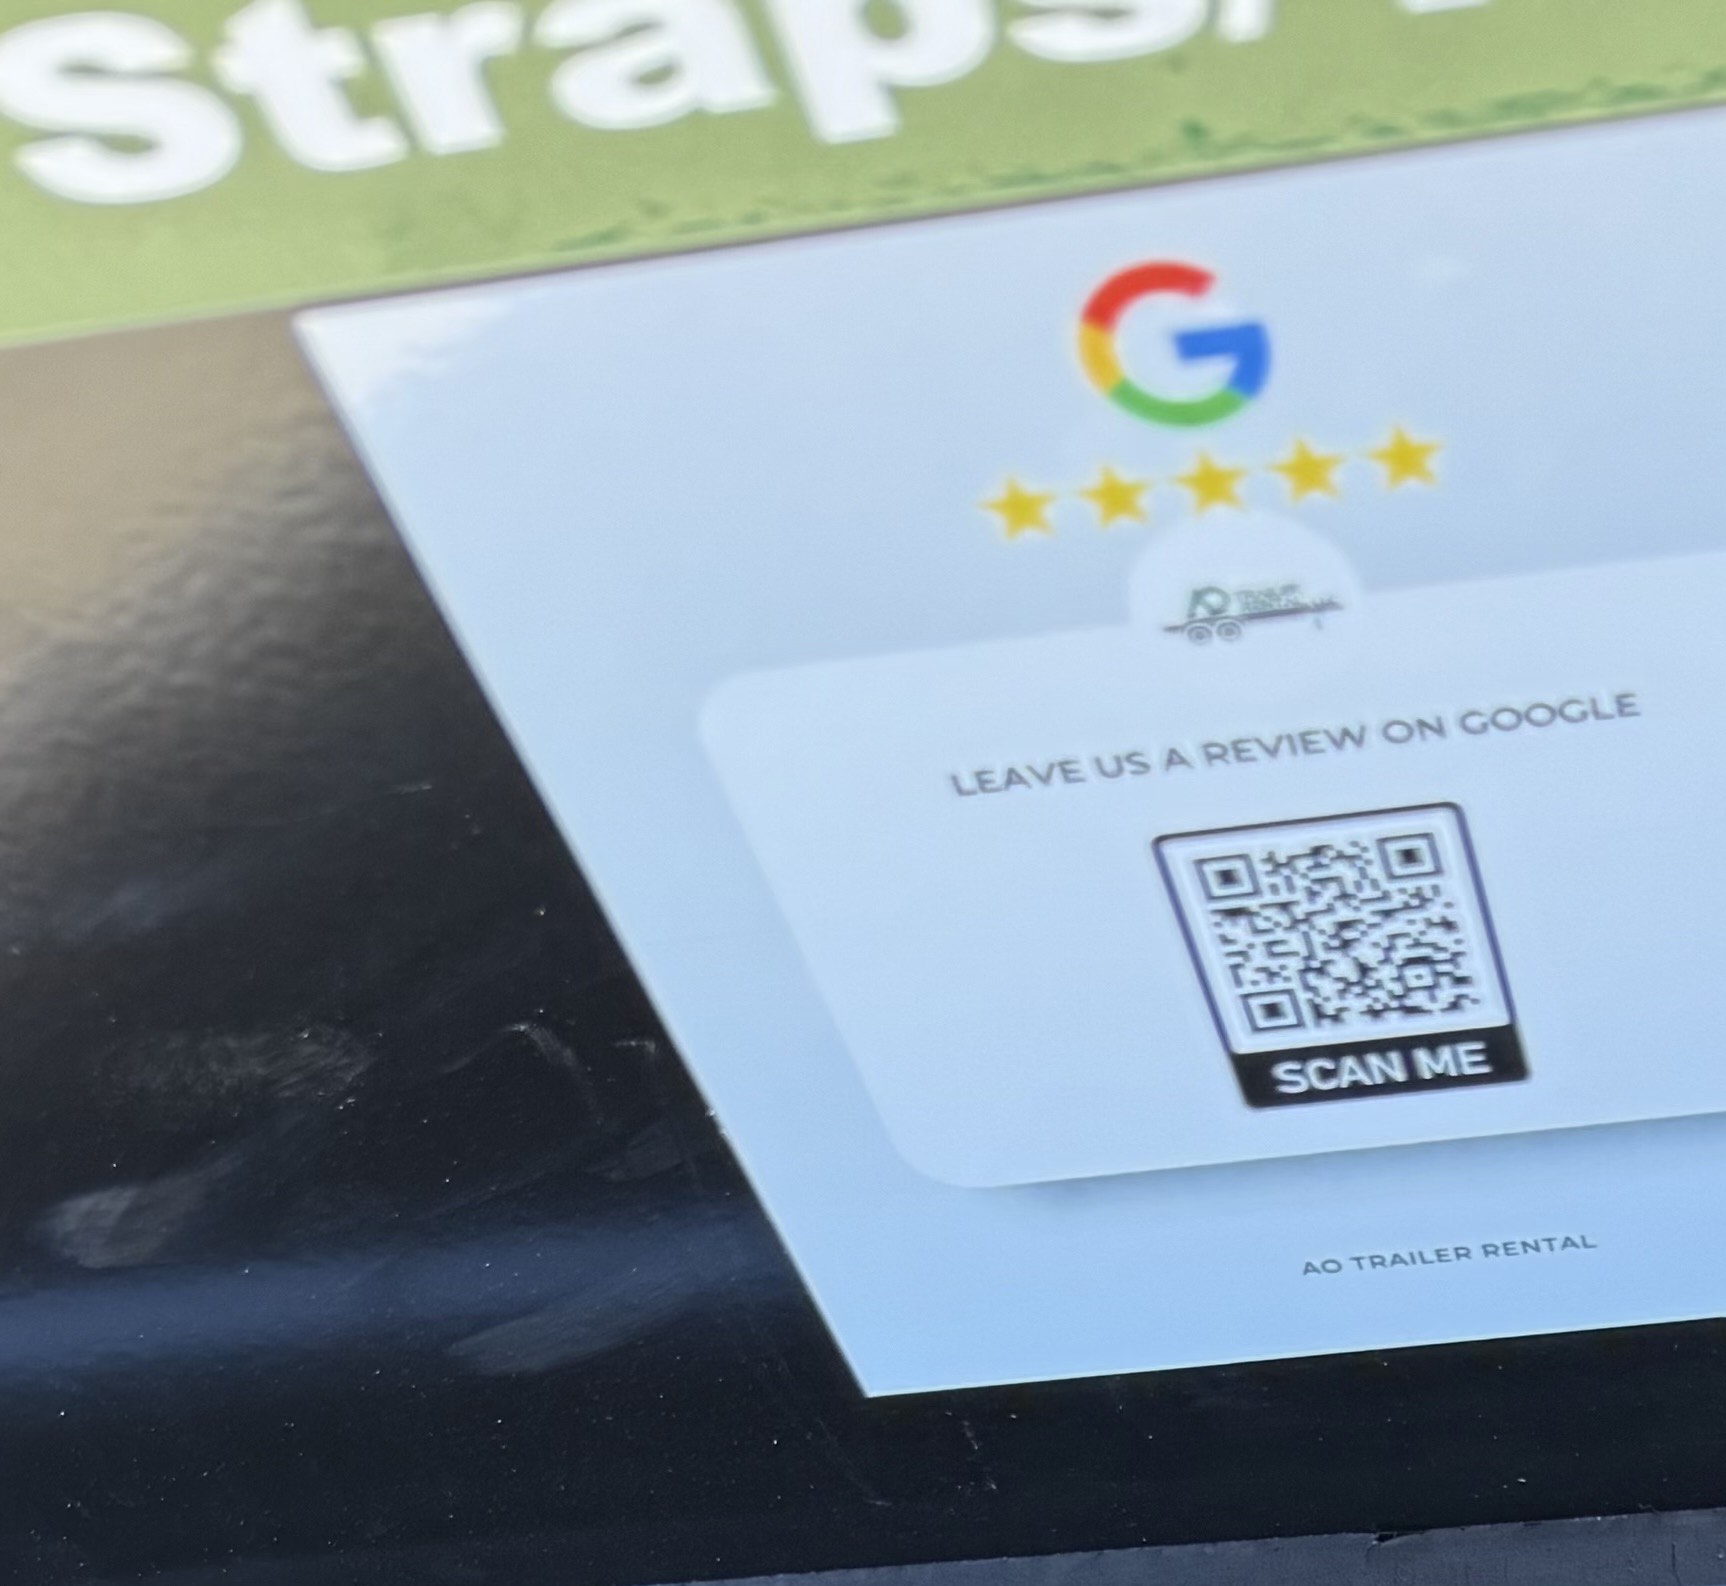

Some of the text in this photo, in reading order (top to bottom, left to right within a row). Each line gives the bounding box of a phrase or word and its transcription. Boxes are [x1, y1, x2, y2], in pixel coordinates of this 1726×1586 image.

[949, 692, 1643, 798] LEAVE US A REVIEW ON GOOGLE
[1270, 1040, 1493, 1096] SCAN ME
[1301, 1231, 1598, 1278] AO TRAILER RENTAL
